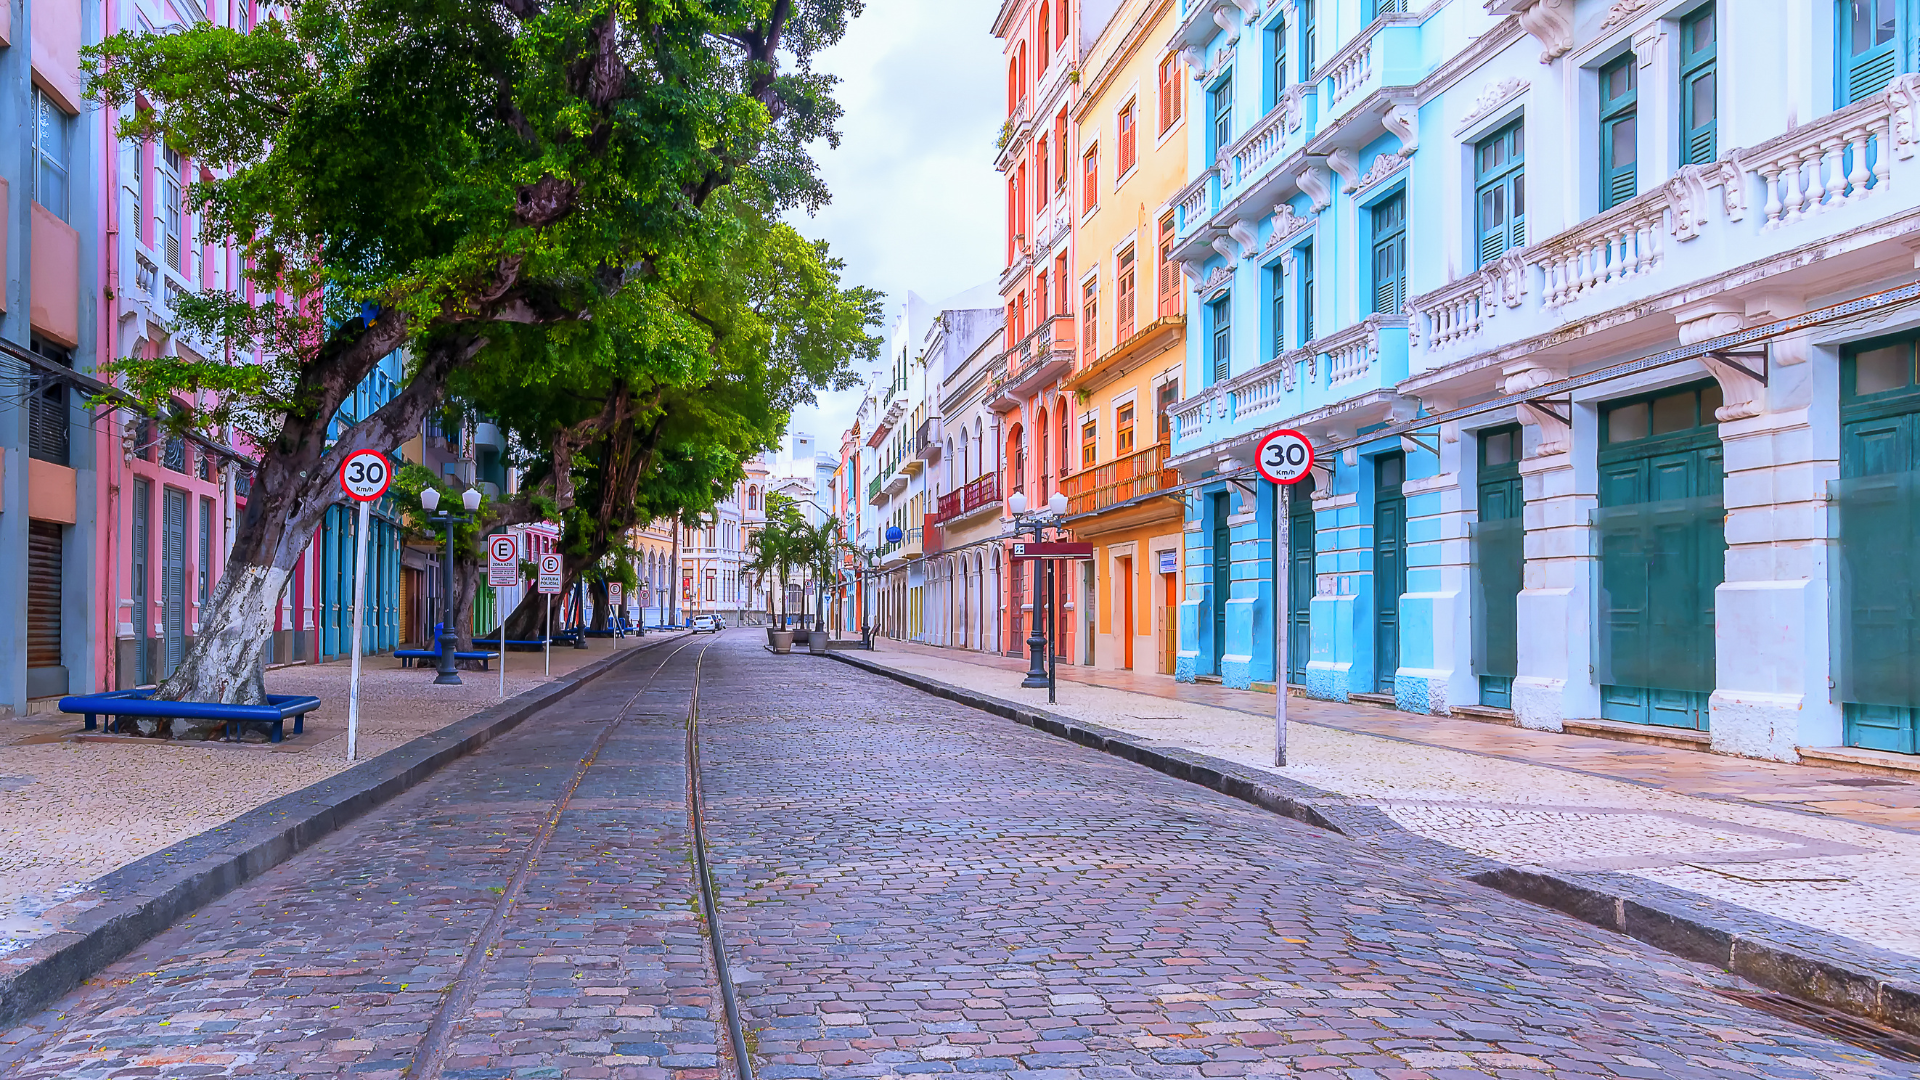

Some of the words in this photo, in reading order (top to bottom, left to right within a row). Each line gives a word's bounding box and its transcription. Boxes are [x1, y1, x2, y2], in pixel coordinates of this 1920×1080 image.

[1265, 443, 1305, 467] 30
[348, 461, 384, 484] 30
[498, 543, 508, 556] E
[547, 559, 554, 569] E
